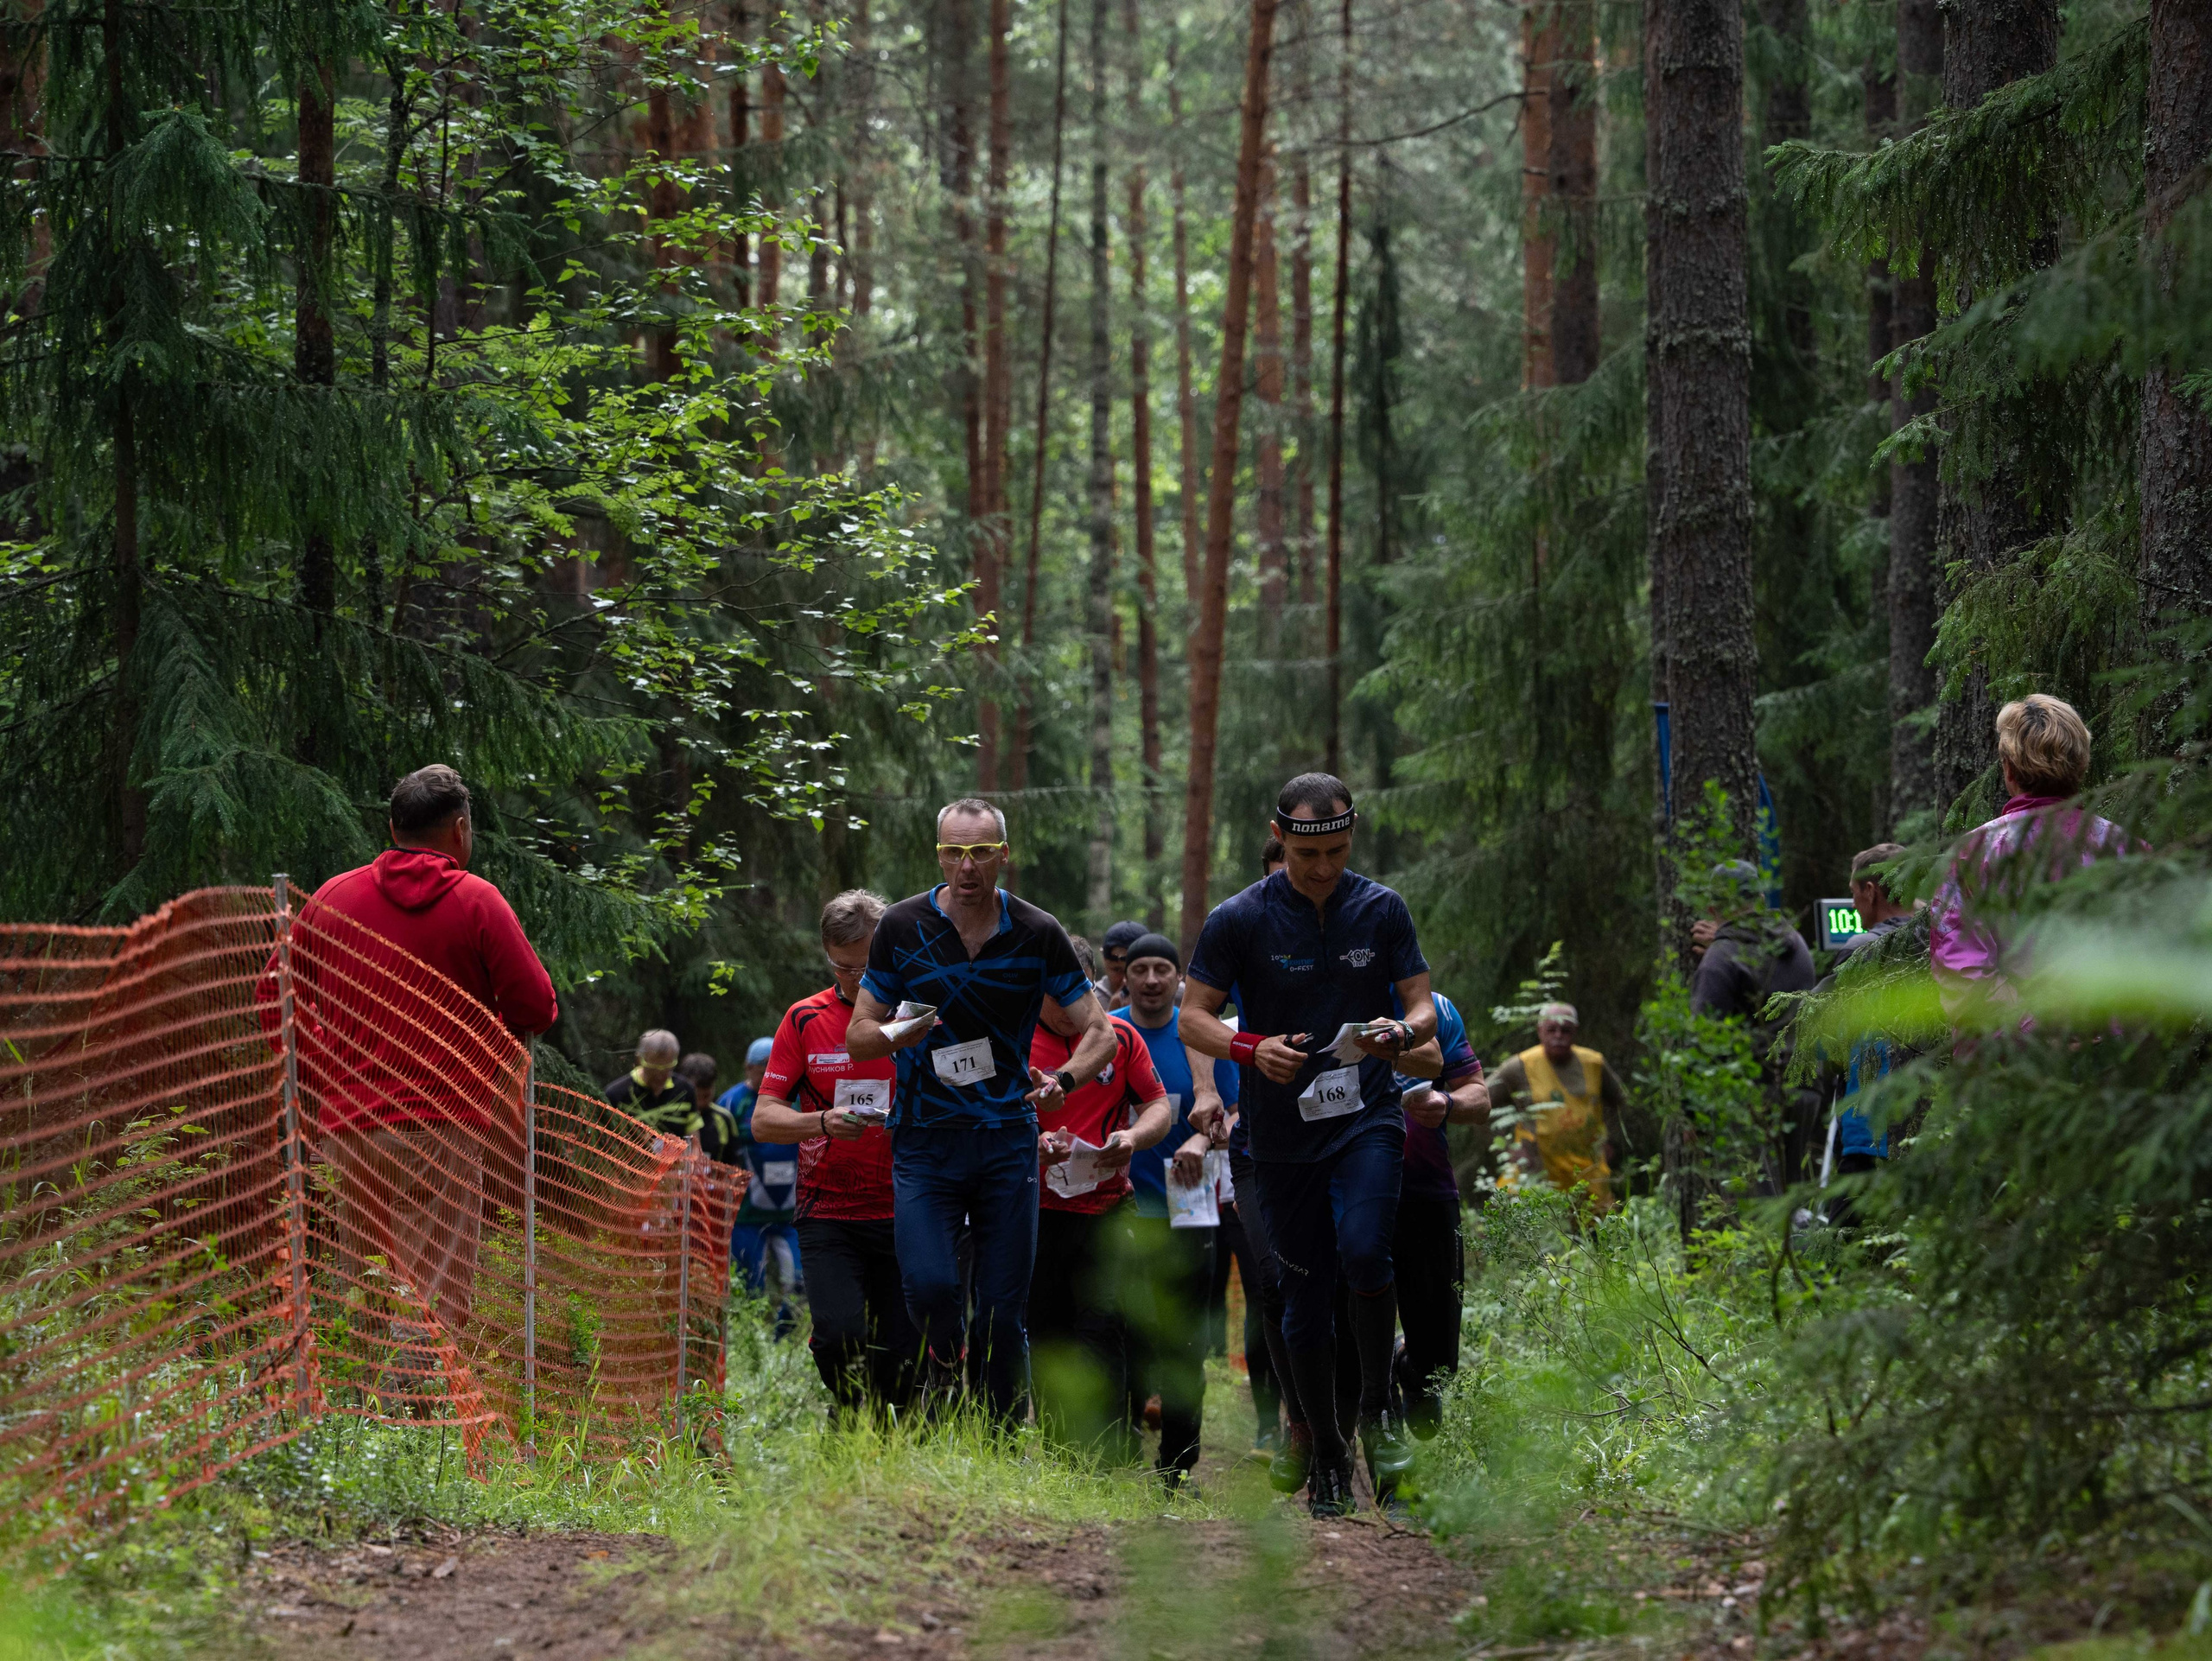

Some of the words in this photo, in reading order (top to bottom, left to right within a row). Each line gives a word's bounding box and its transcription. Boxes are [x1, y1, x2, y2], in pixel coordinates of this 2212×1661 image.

[1292, 817, 1351, 833] noname
[1828, 909, 1867, 933] 10:1
[952, 1056, 976, 1073] 171
[770, 1072, 788, 1082] team
[849, 1093, 874, 1106] 165
[1318, 1085, 1345, 1104] 168
